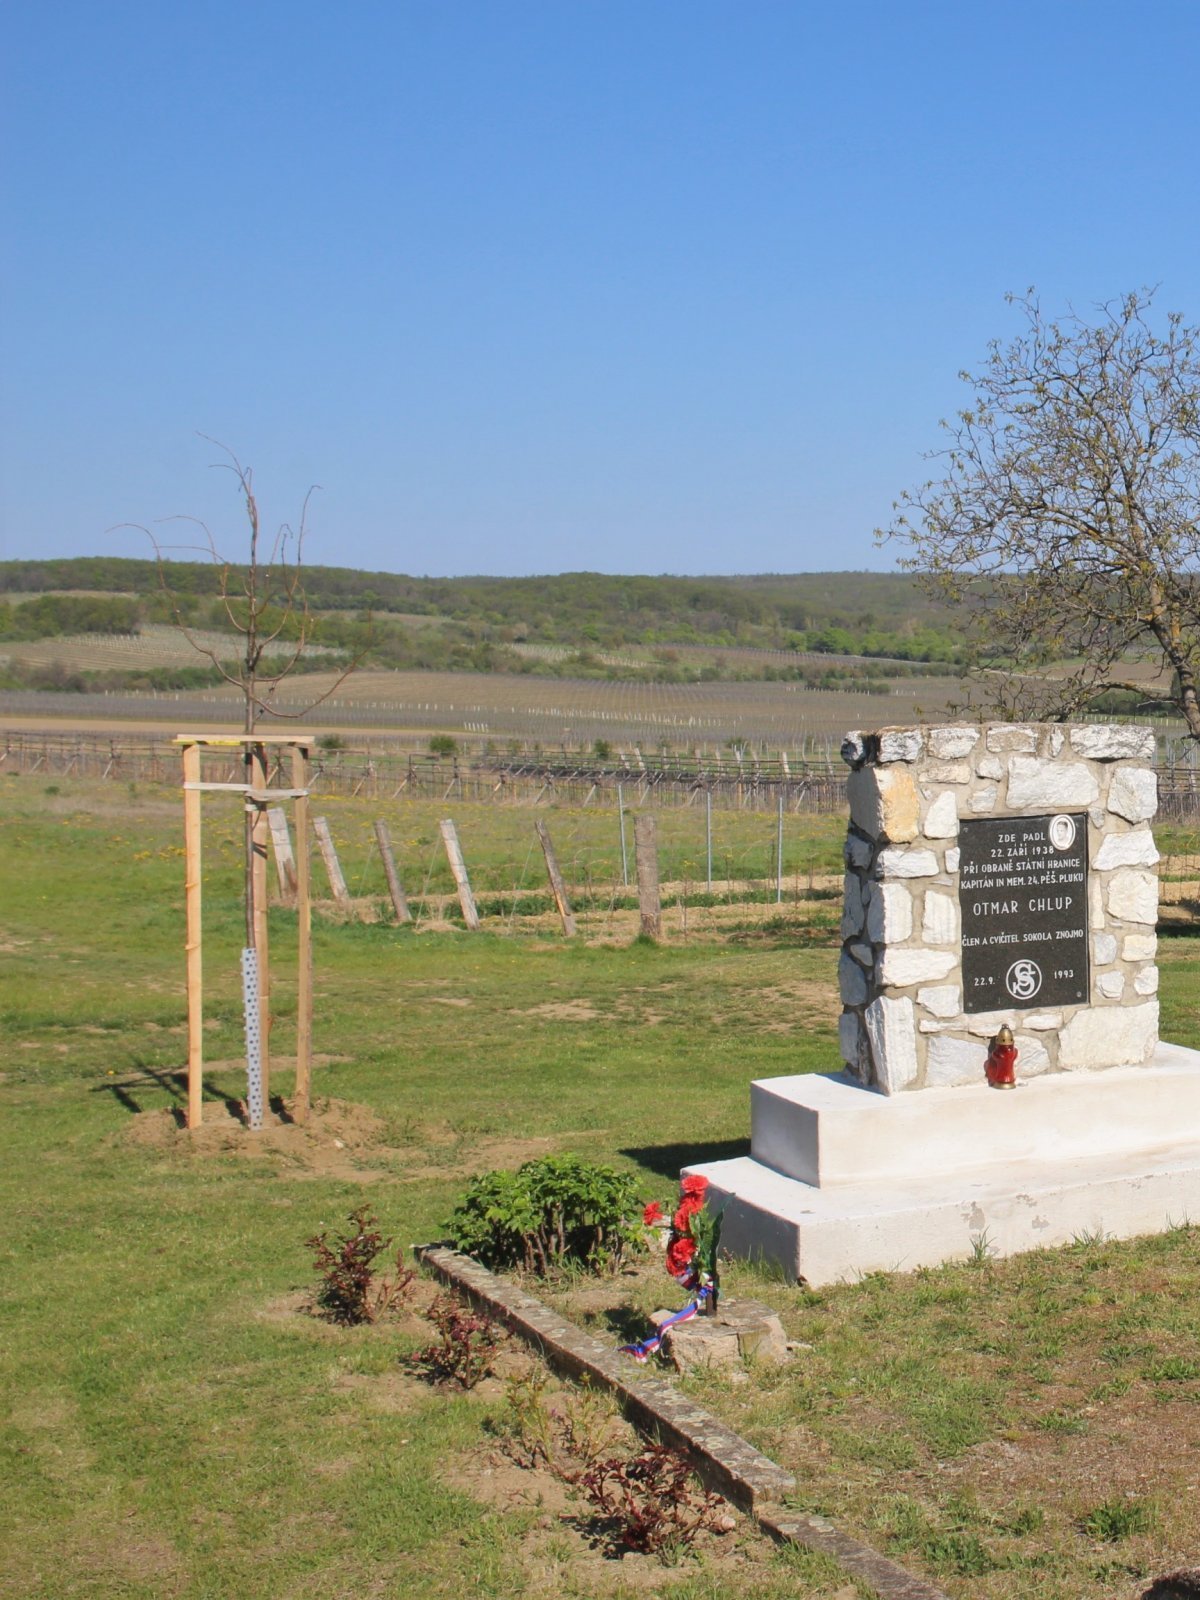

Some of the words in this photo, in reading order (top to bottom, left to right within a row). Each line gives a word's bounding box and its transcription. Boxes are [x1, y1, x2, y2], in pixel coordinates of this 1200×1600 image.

[998, 834, 1016, 842] ZDE
[1023, 832, 1046, 841] PADL
[991, 849, 1004, 857] 22.
[1007, 843, 1027, 856] ZÁŘÍ
[1032, 846, 1054, 855] 1938
[963, 861, 978, 874] PŘI
[981, 860, 1013, 873] OBRANĚ
[1016, 857, 1044, 871] STÁTNÍ
[1047, 859, 1080, 869] HRANICE
[961, 876, 993, 889] KAPITÁN
[996, 878, 1004, 887] IN
[1007, 877, 1026, 886] MEM.
[1059, 873, 1083, 883] PLUKU
[973, 900, 1018, 915] OTMAR
[1029, 897, 1072, 911] CHLUP
[962, 935, 980, 946] ČLEN
[990, 932, 1019, 944] CVIČITEL
[1023, 932, 1052, 942] SOKOLA
[1056, 929, 1083, 939] ZNOJMO
[1054, 970, 1074, 979] 1993
